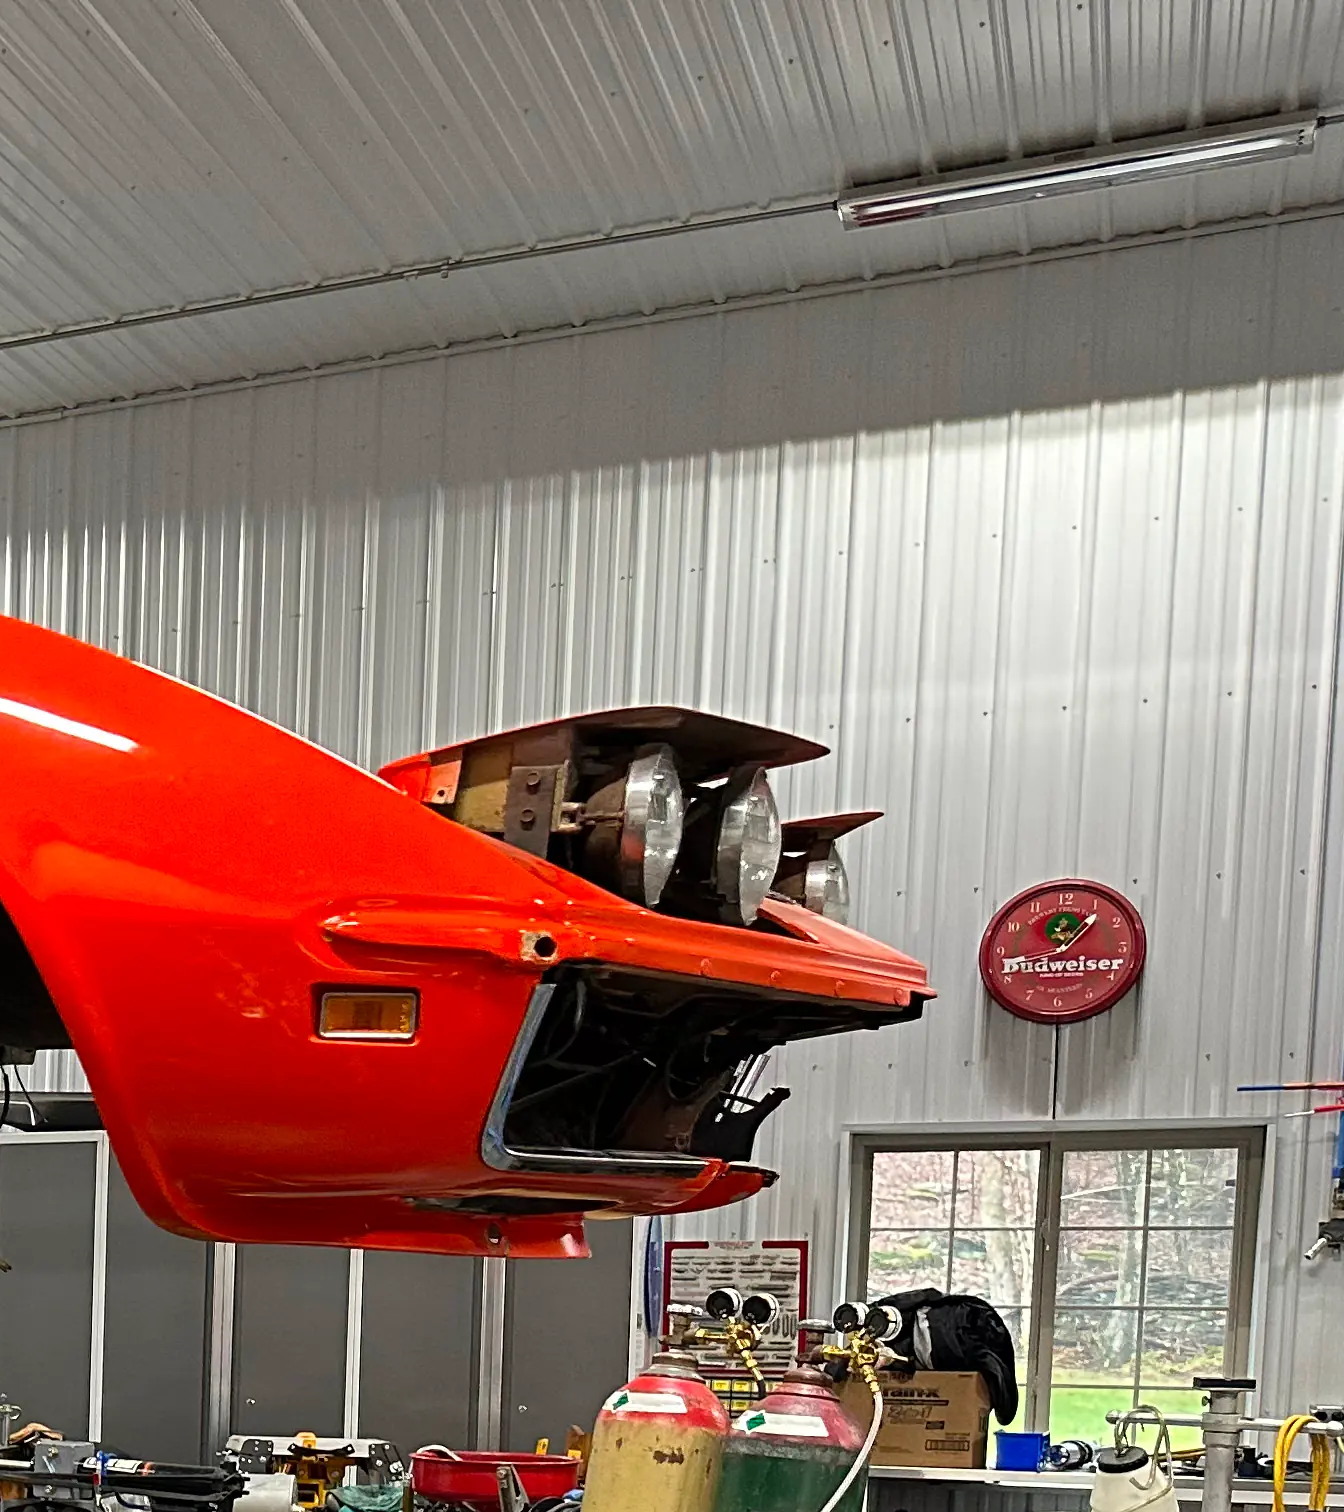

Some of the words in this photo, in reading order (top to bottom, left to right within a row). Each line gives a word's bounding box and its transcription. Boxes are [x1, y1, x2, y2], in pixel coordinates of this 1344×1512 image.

[1058, 893, 1073, 905] 12
[1030, 902, 1040, 913] 11
[1007, 921, 1020, 933] 10
[1112, 917, 1121, 928] 2
[997, 946, 1005, 956] 9
[1118, 941, 1127, 953] 3
[1001, 955, 1124, 974] Budweiser
[1003, 974, 1012, 984] 8
[1026, 989, 1035, 1001] 7
[1085, 988, 1093, 999] 5
[1053, 996, 1062, 1007] 6
